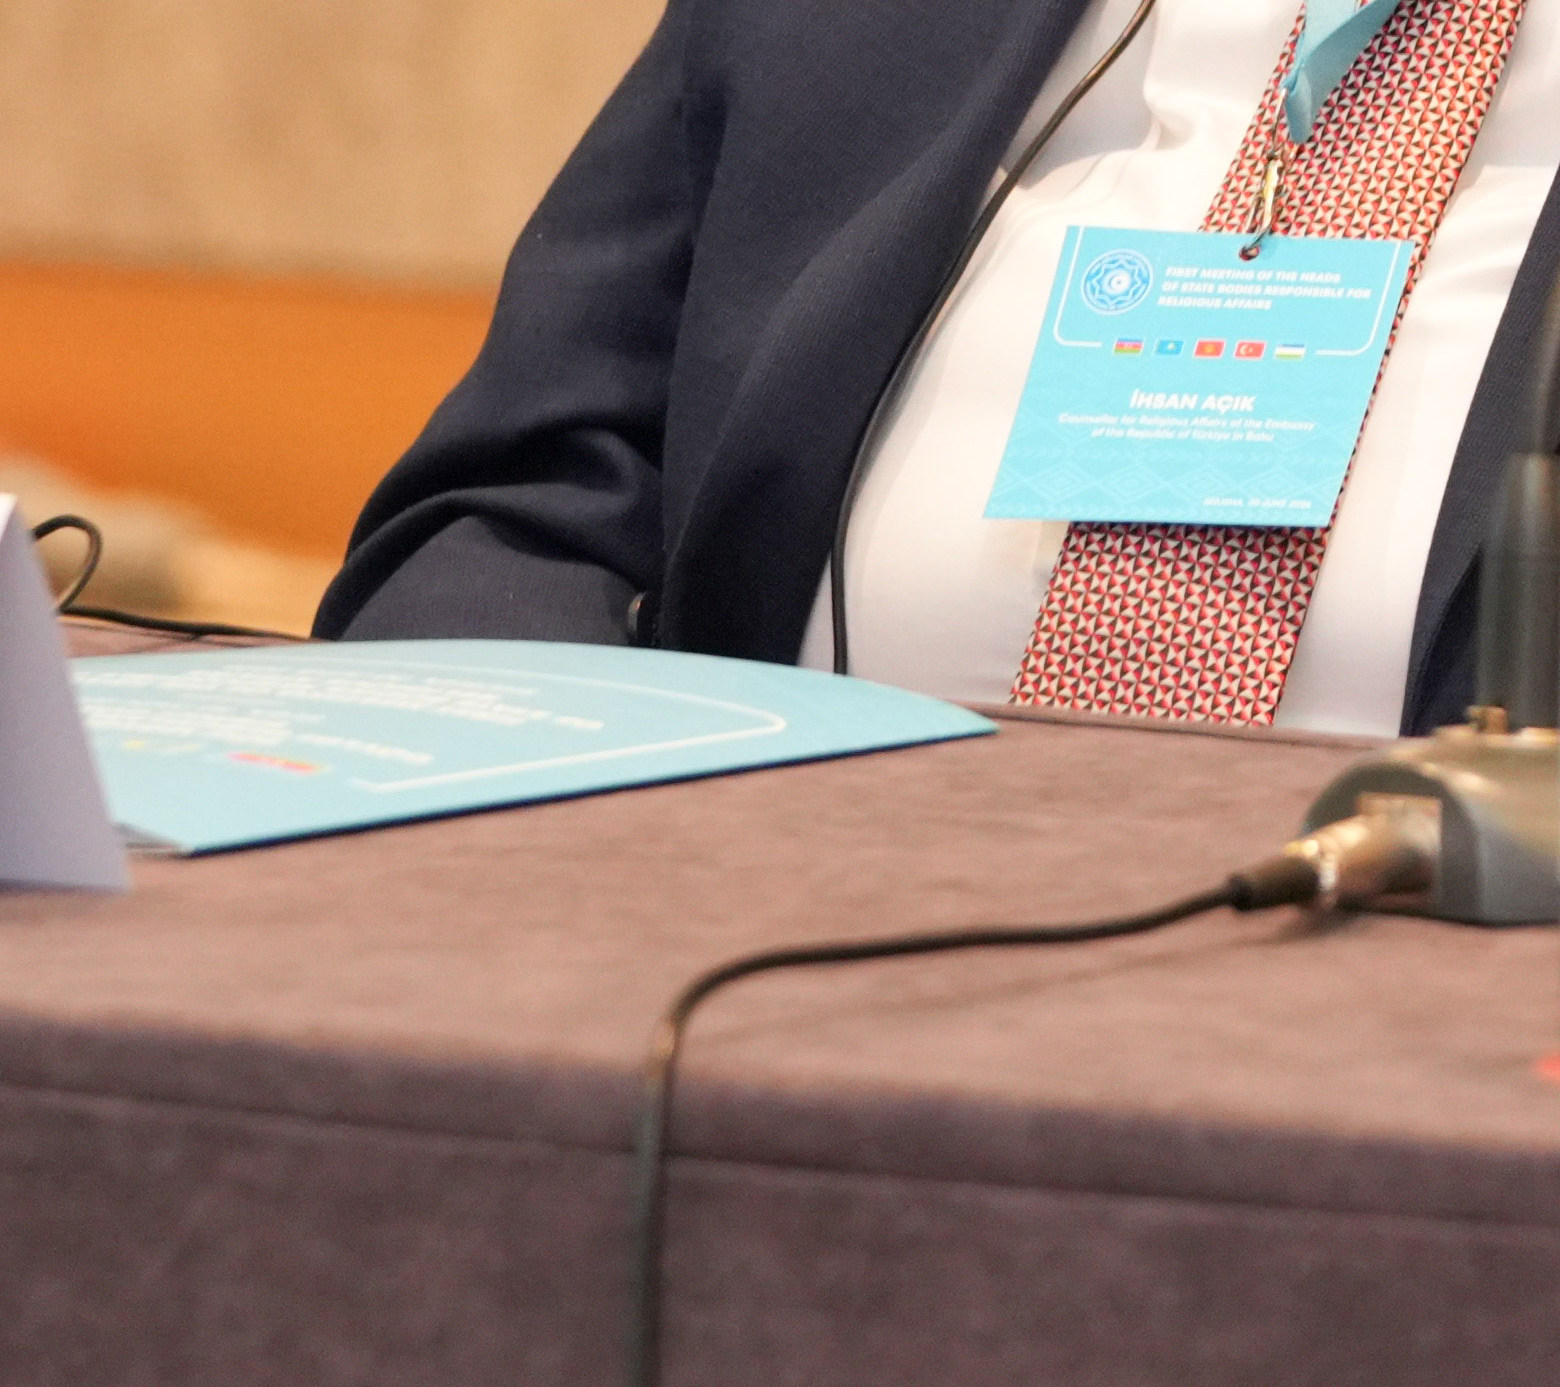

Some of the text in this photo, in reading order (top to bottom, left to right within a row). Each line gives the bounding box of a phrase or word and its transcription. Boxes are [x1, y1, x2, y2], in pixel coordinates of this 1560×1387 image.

[1165, 267, 1341, 284] FIRST MEETING OF THE HEADS
[1162, 281, 1372, 299] OF STATE BODIES RESPONSIBLE FOR
[1157, 295, 1272, 310] RELIGIOUS AFFAIRS
[1201, 393, 1257, 415] AÇIK
